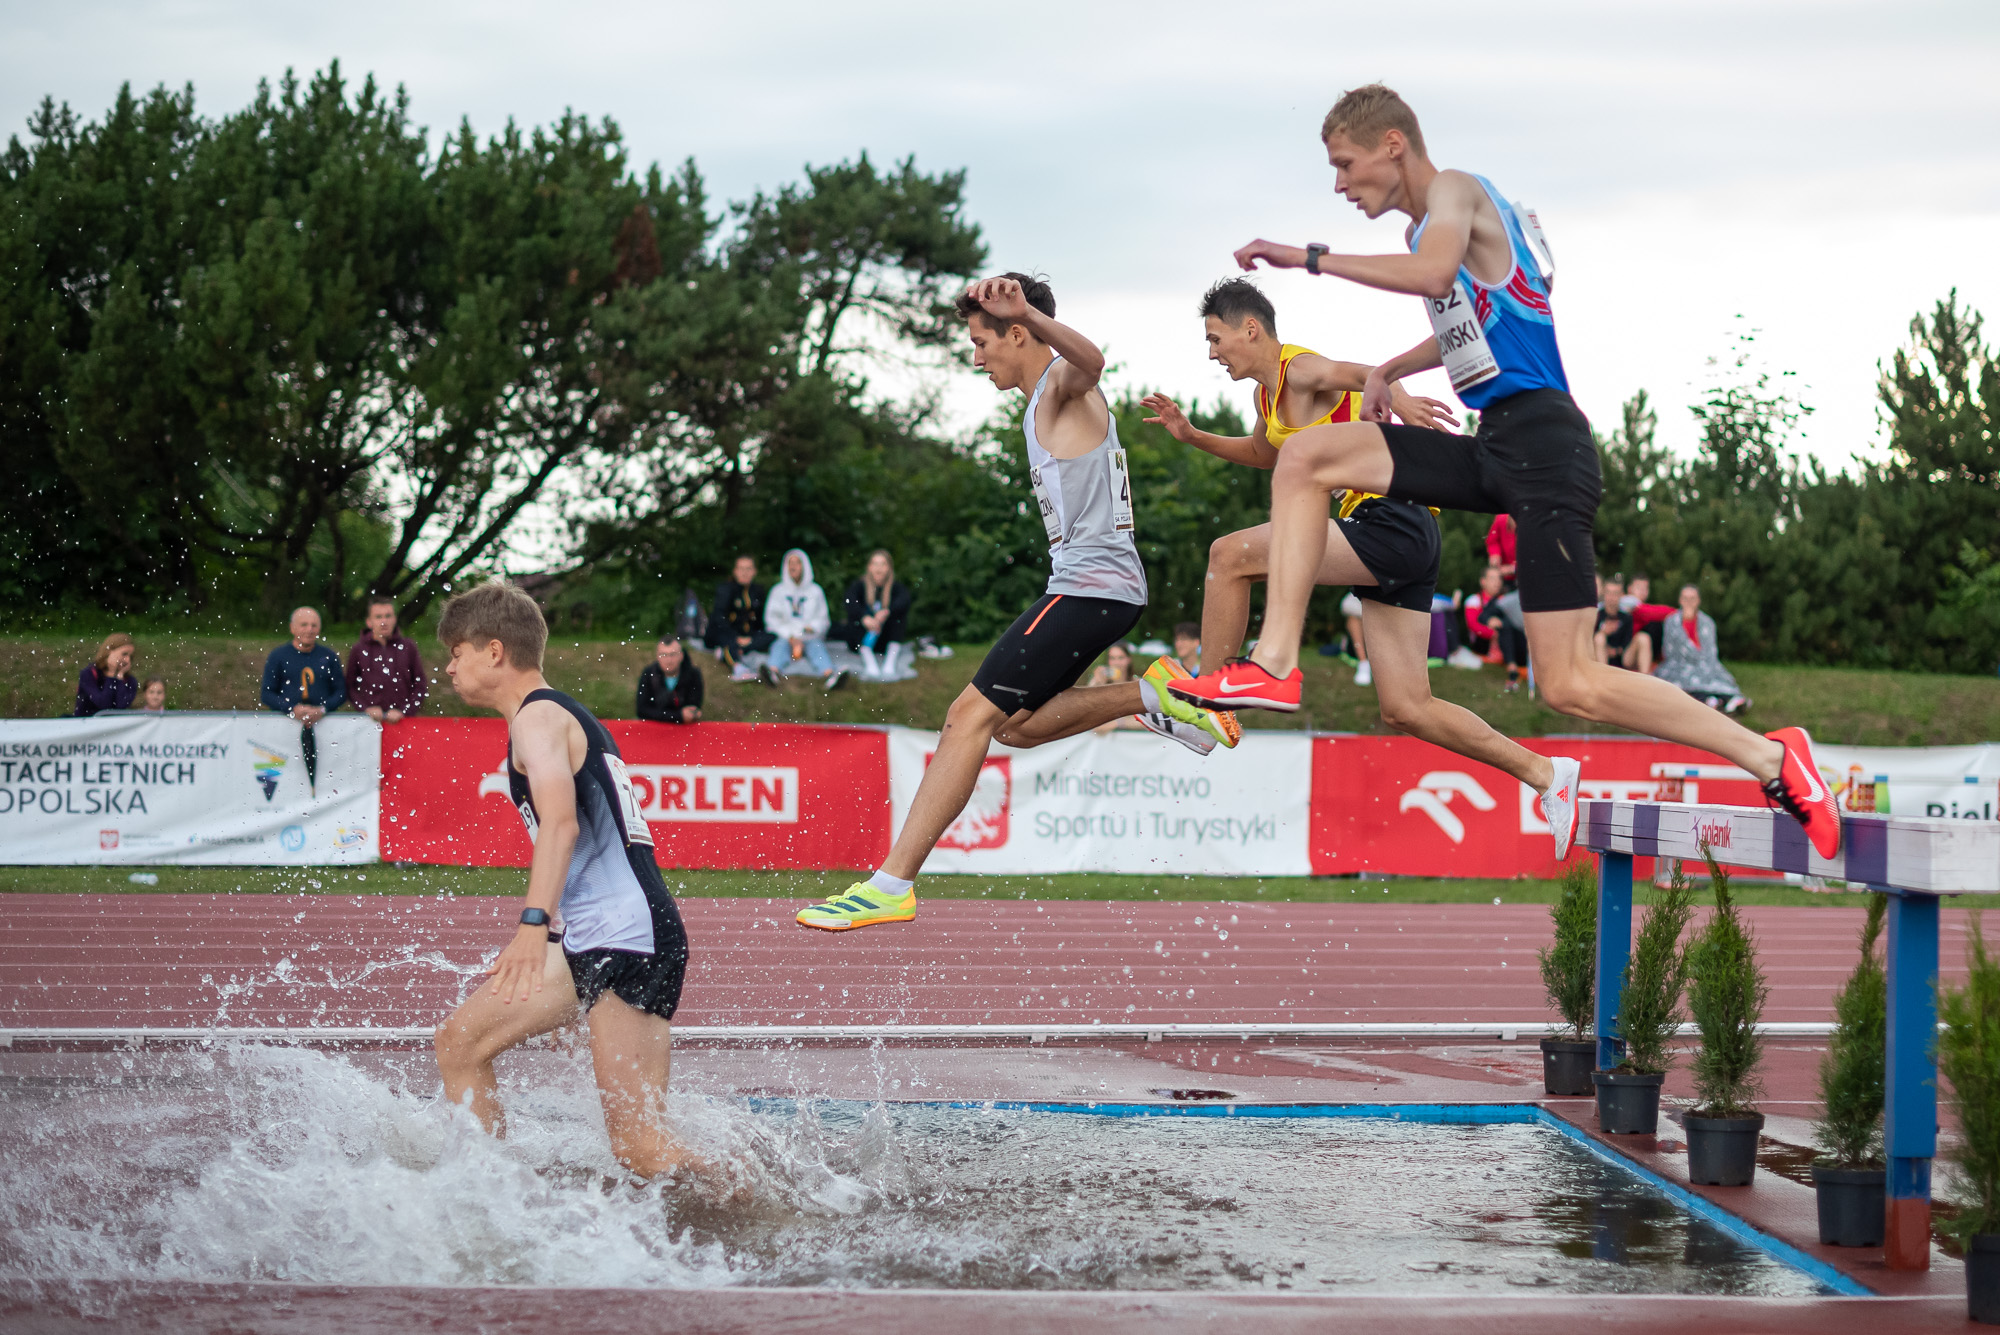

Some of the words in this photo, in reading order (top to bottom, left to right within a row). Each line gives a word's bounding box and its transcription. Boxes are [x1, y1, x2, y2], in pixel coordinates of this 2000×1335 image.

[1429, 287, 1462, 317] 62
[0, 744, 42, 758] LSKA
[47, 743, 135, 758] OLIMPIADA
[140, 742, 229, 759] MŁODZIEŻY
[0, 761, 72, 784] TACH
[83, 761, 196, 784] LETNICH
[1034, 771, 1211, 798] Ministerstwo
[629, 775, 785, 812] ORLEN
[1034, 811, 1126, 844] Sportu
[1135, 811, 1141, 839] i
[1150, 811, 1277, 845] Turystyki
[1700, 817, 1732, 851] polanik
